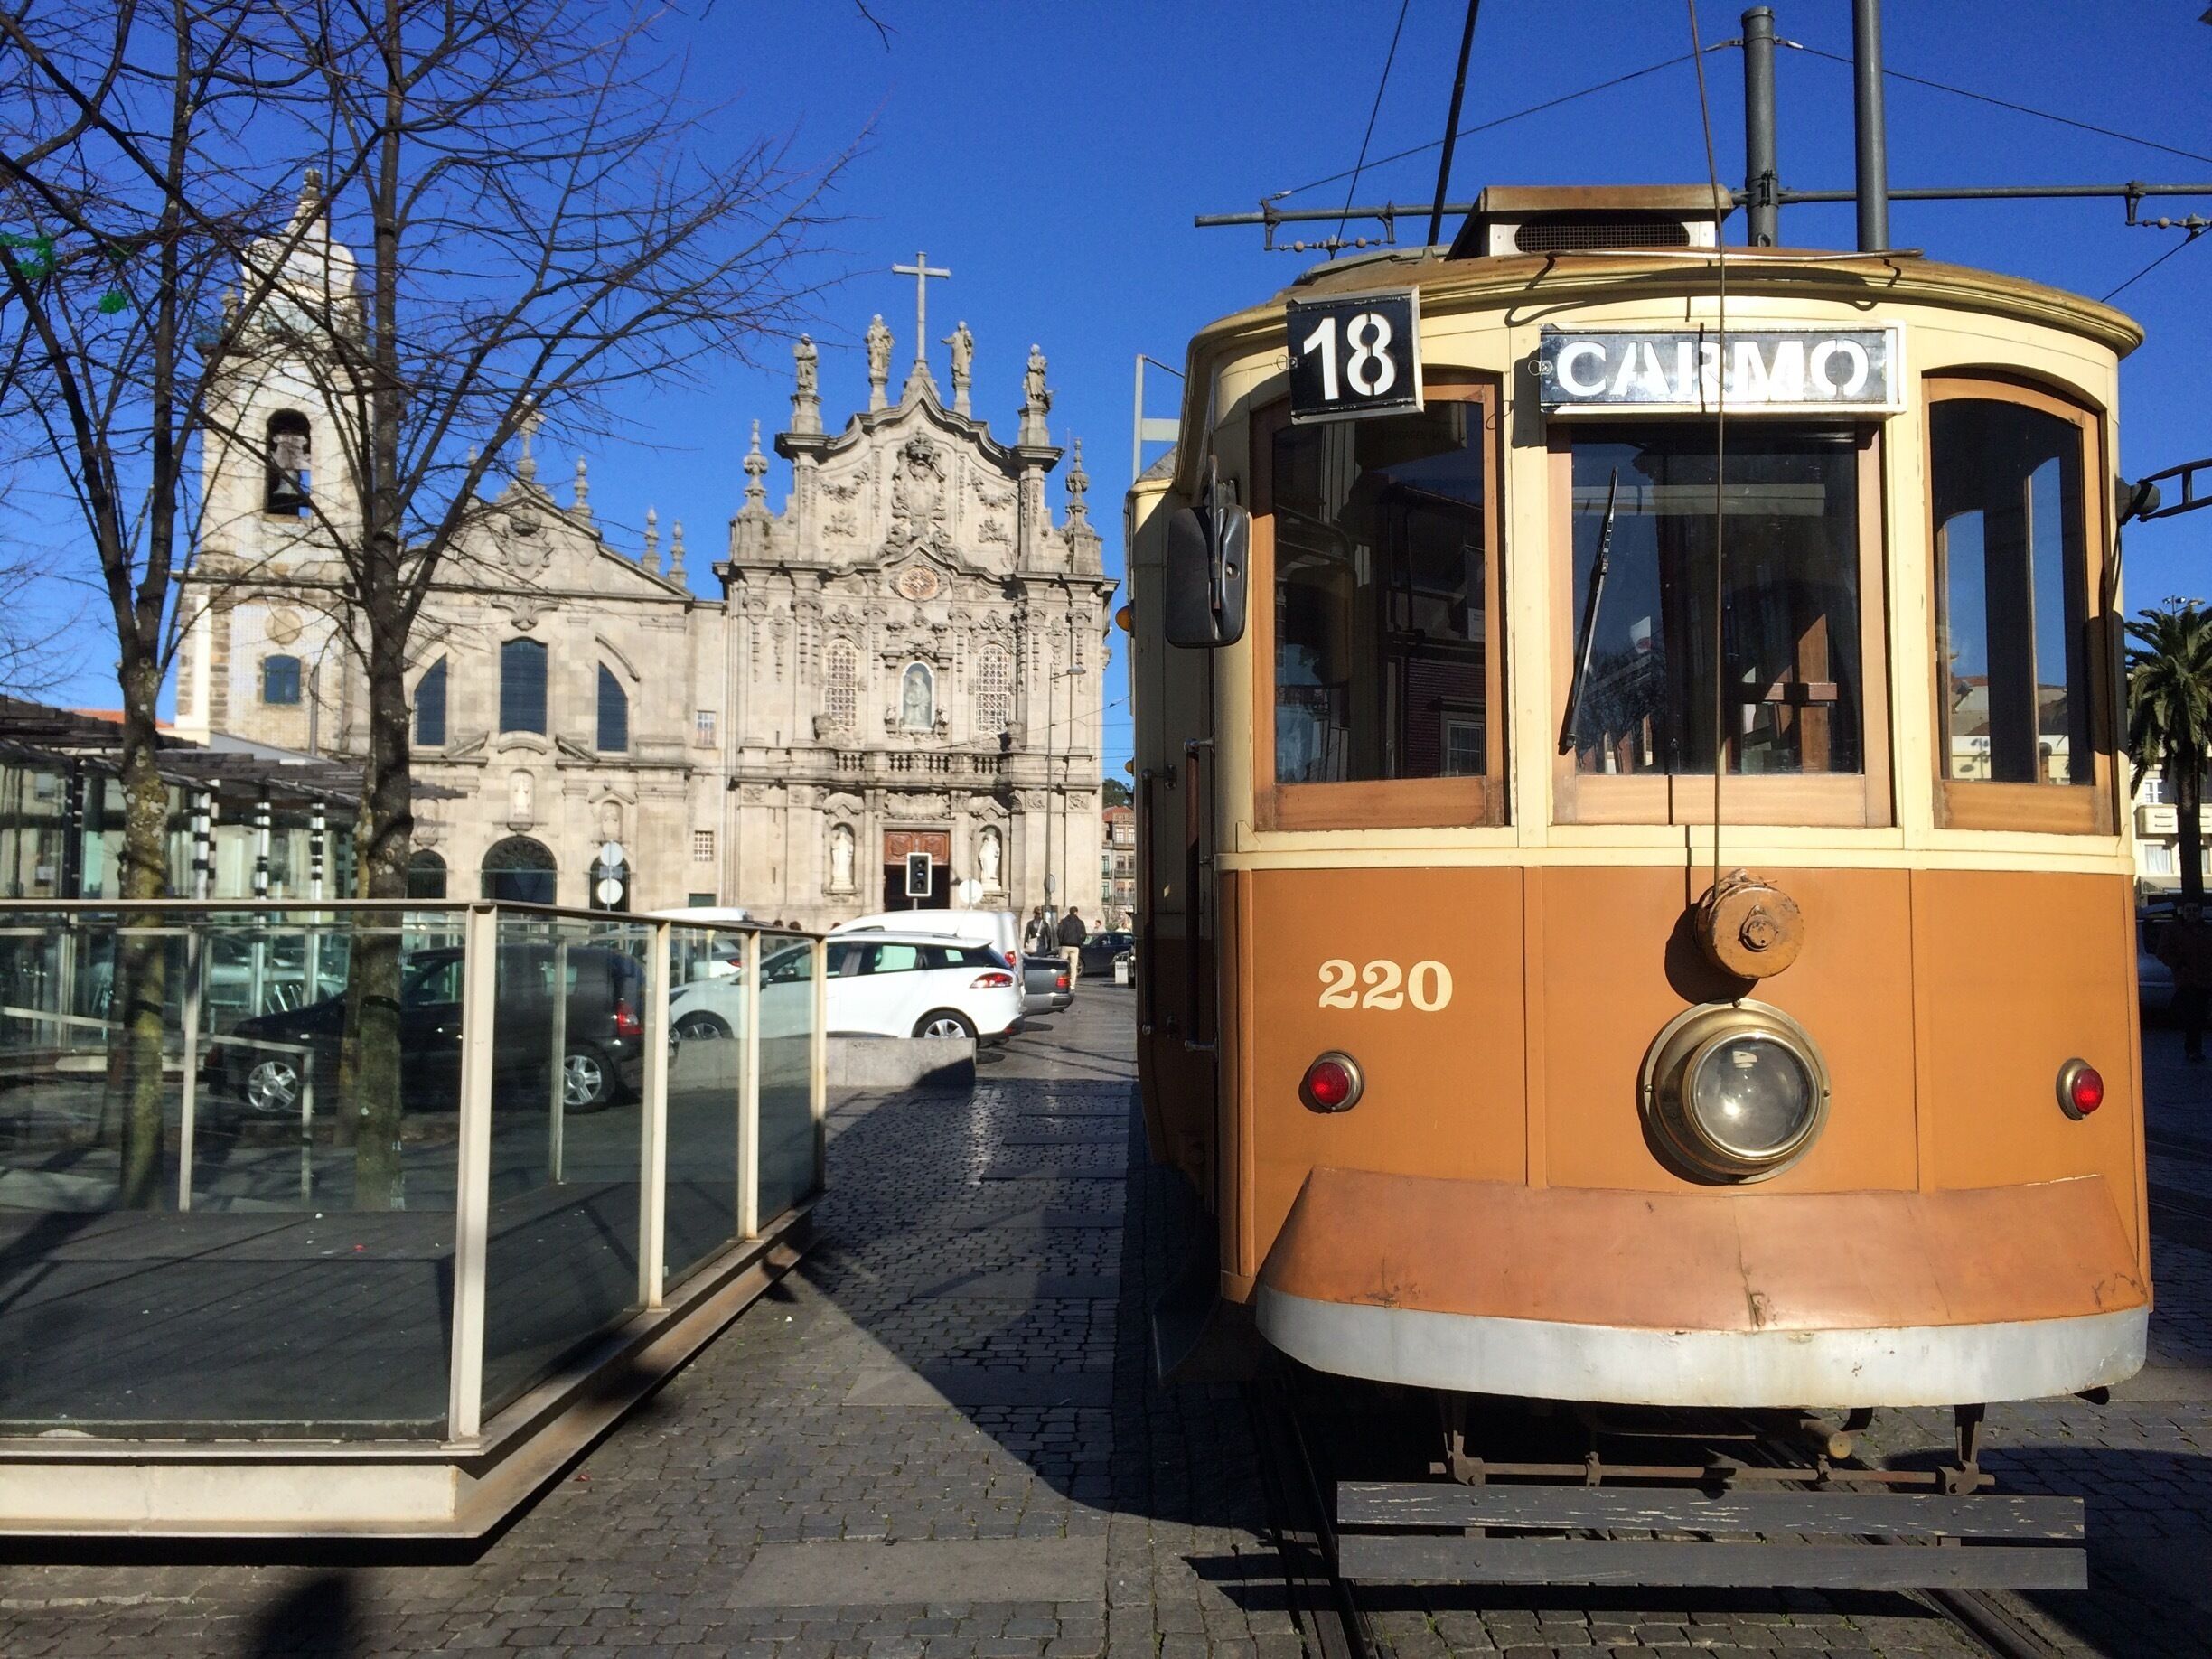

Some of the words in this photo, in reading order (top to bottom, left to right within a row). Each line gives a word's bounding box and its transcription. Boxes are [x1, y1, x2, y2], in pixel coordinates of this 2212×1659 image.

[1303, 312, 1397, 400] 18
[1557, 339, 1869, 397] CARMO
[1318, 959, 1453, 1012] 220
